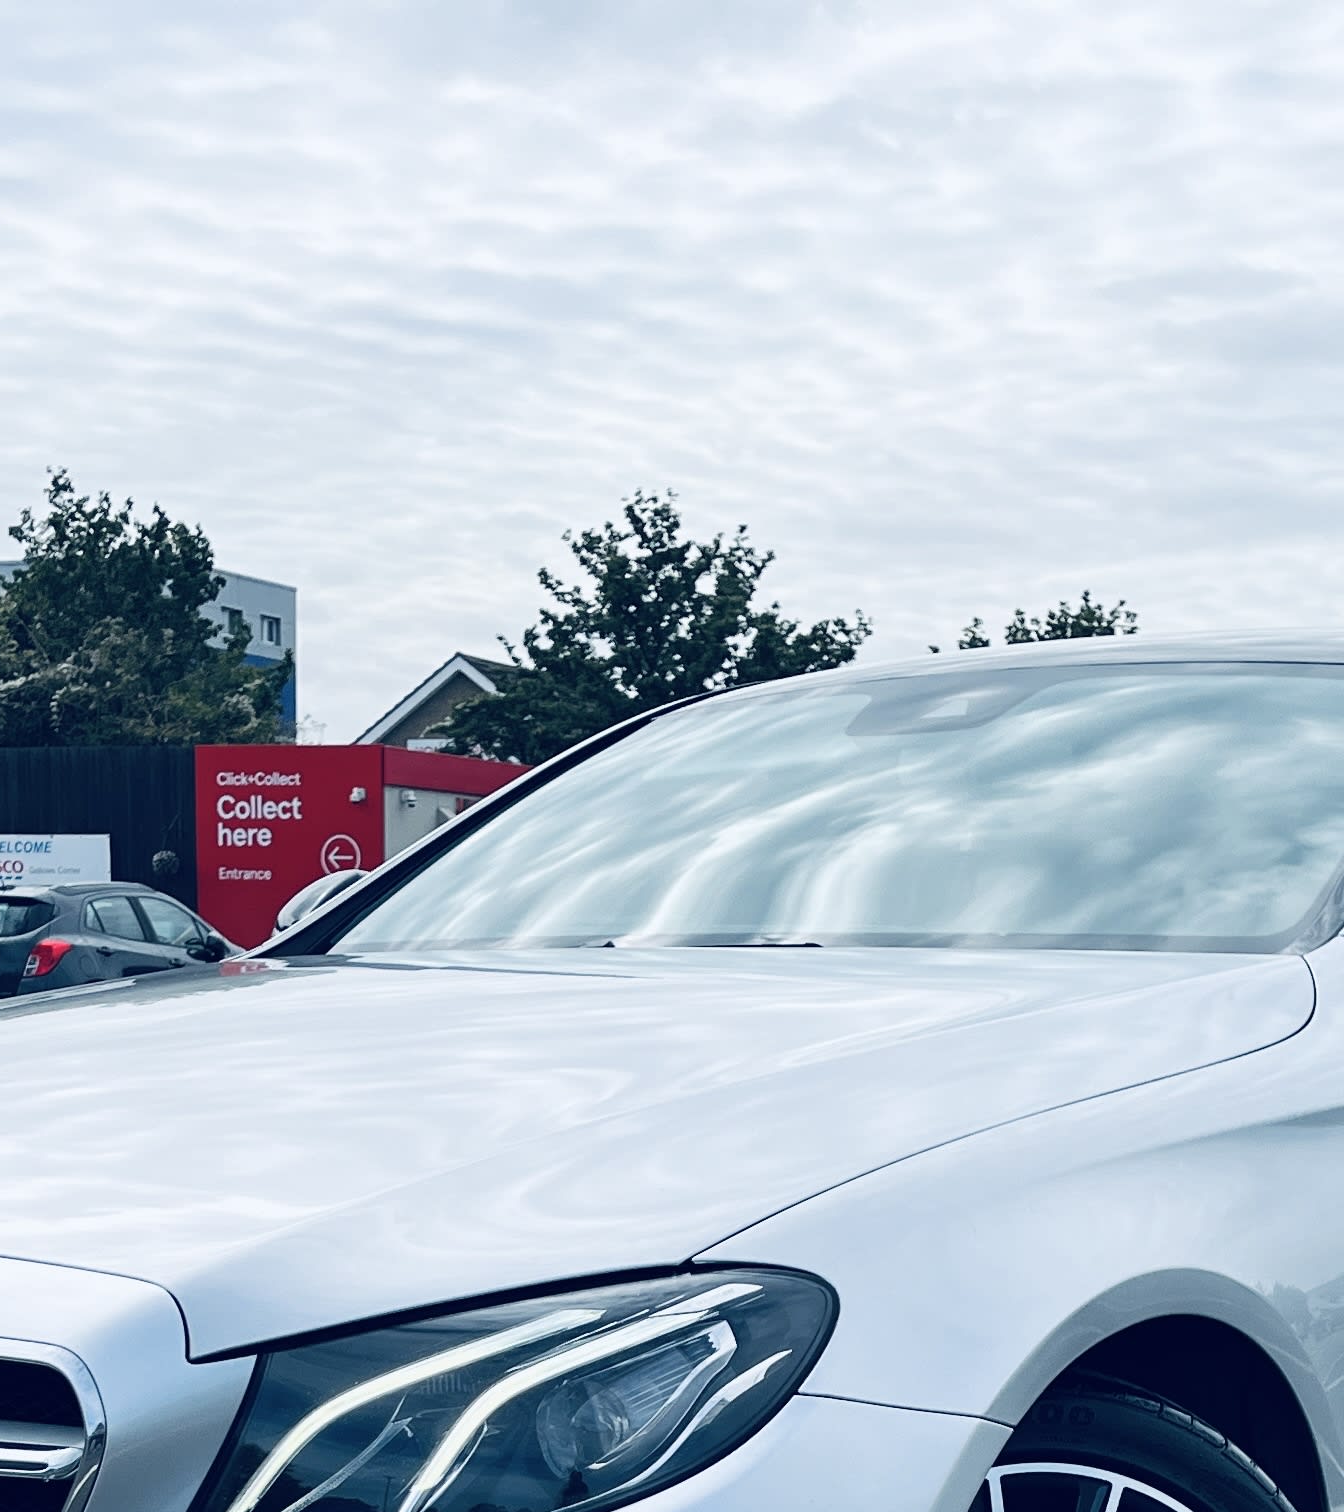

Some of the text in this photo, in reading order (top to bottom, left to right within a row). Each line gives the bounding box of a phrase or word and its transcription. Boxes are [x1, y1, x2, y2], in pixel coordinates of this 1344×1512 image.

[216, 771, 302, 786] Click+Collect
[217, 794, 303, 820] Collect
[217, 822, 273, 847] here
[218, 867, 273, 880] Entrance
